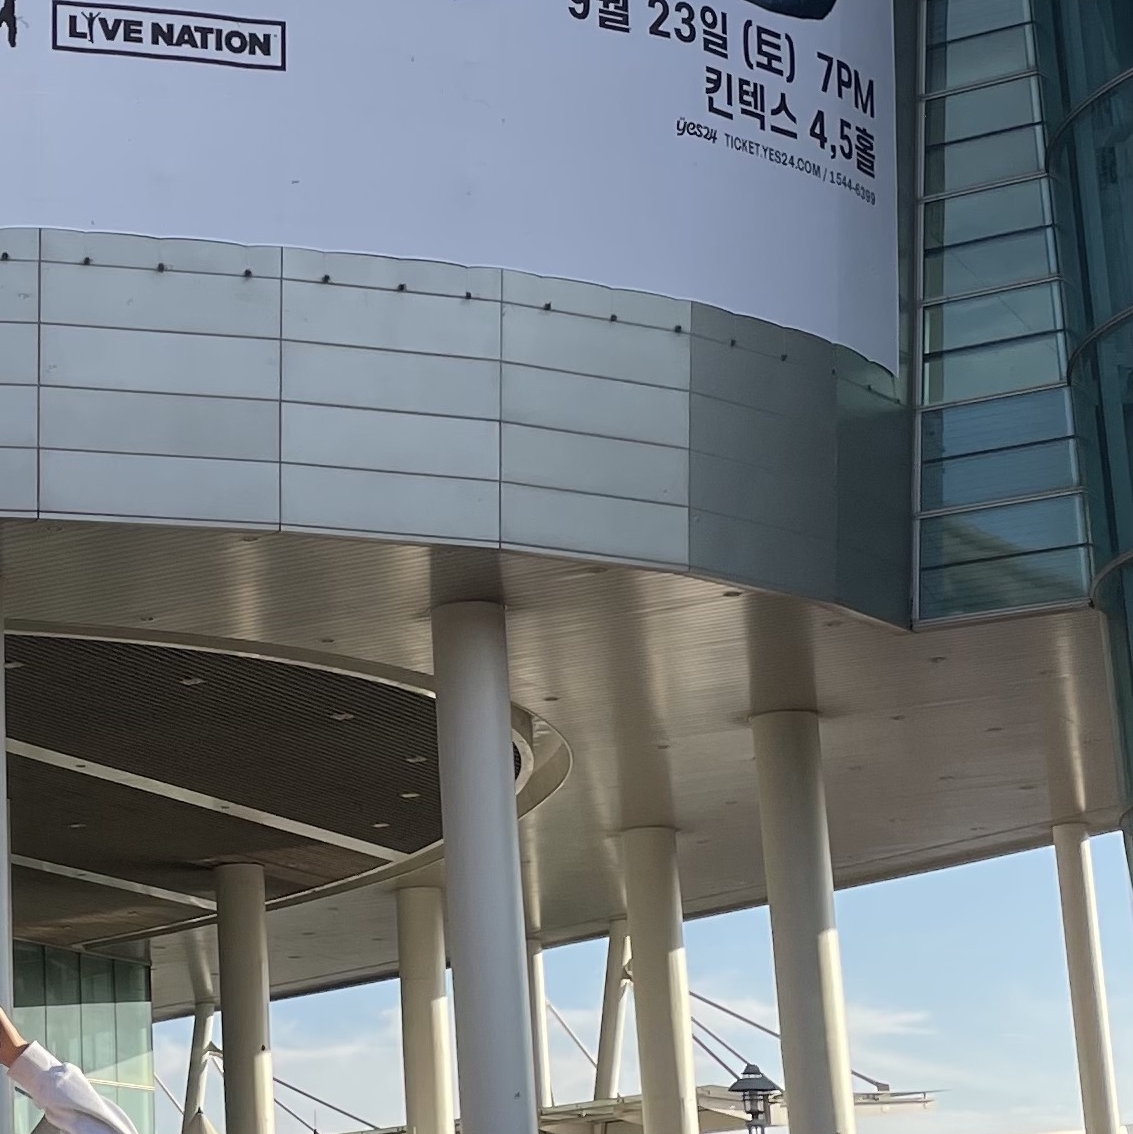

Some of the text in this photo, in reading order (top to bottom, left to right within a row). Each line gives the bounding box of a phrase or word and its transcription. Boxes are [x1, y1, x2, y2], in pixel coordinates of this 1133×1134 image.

[69, 12, 271, 56] LIVE NATION
[647, 0, 729, 59] 23일
[743, 20, 796, 84] (토)
[816, 51, 875, 119] 7PM
[676, 117, 718, 144] yes24
[724, 133, 822, 181] TICKET.YES24.COM
[829, 170, 876, 206] 1544-6399
[705, 65, 876, 179] 킨텍스 4,5홀
